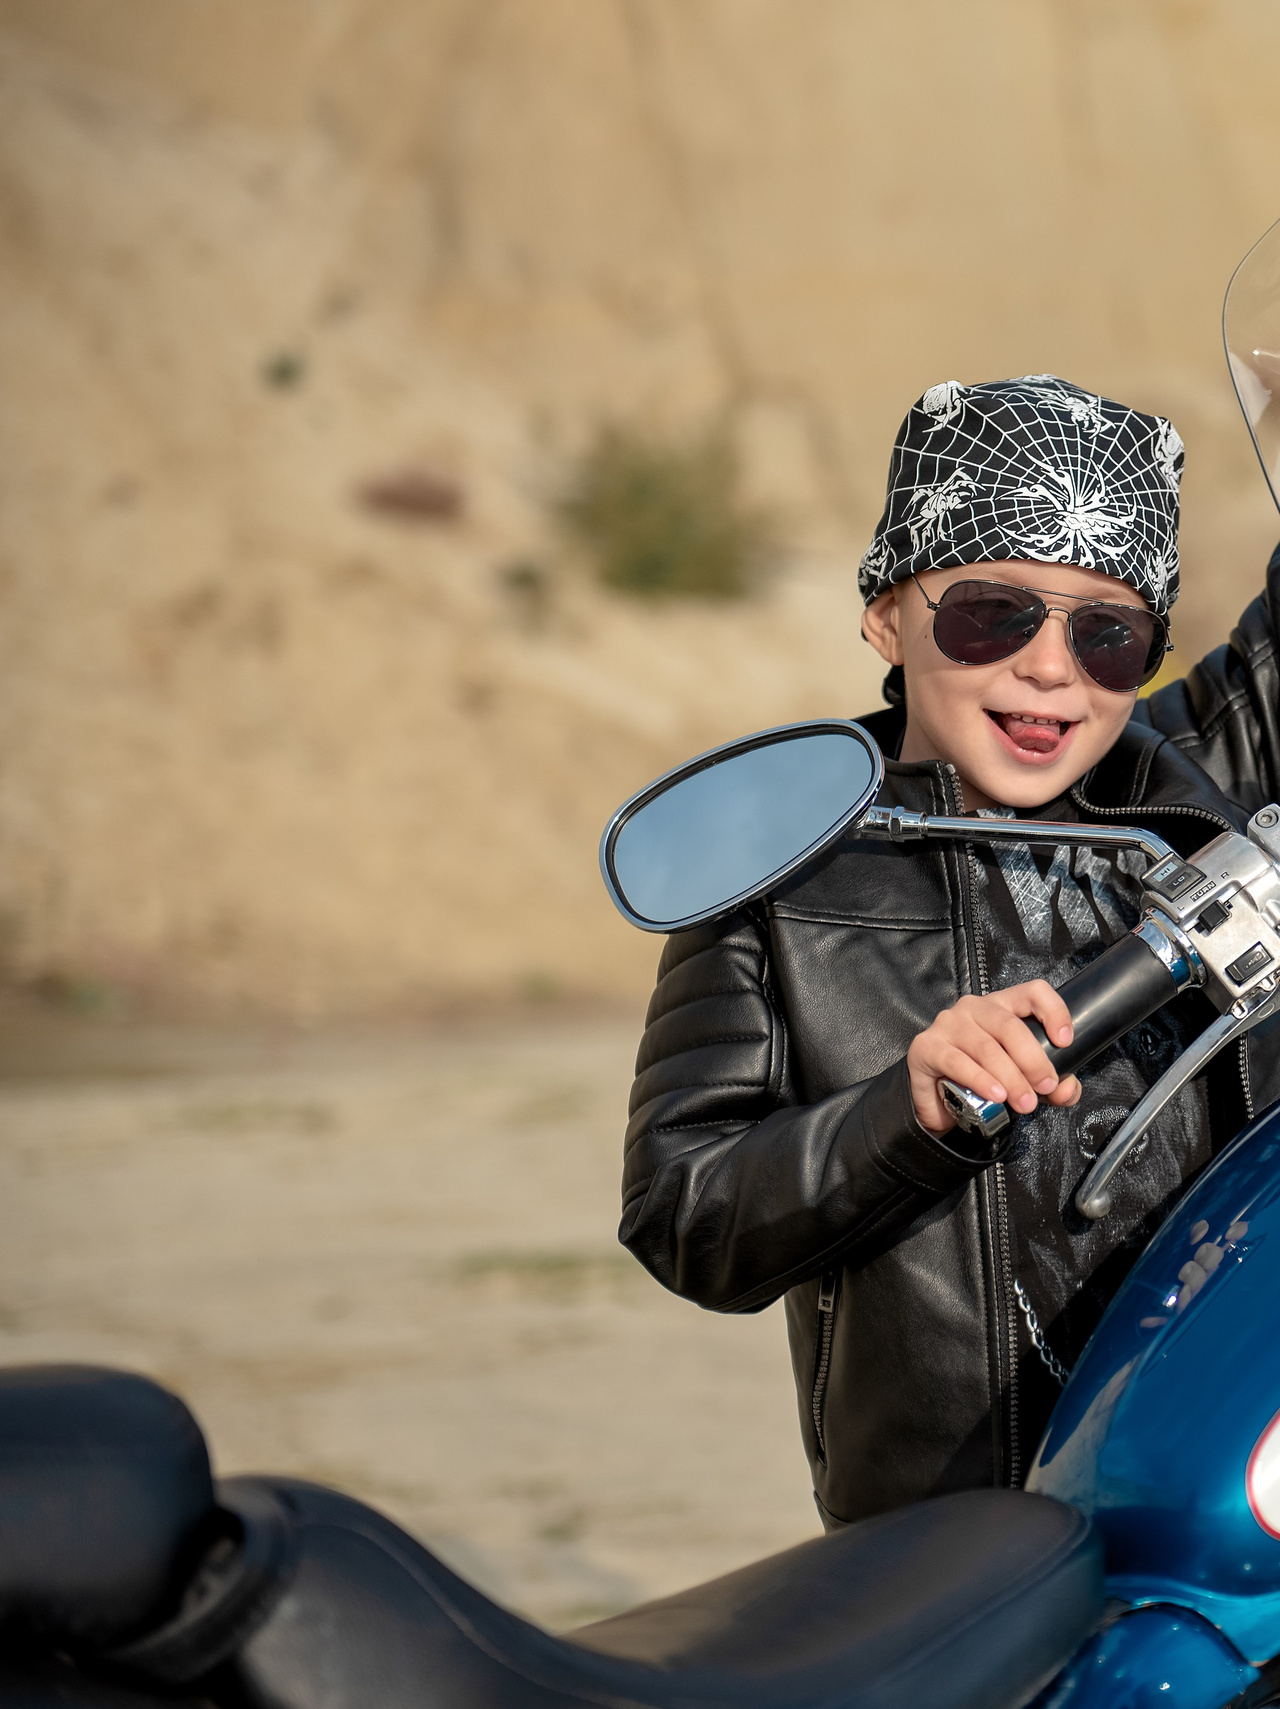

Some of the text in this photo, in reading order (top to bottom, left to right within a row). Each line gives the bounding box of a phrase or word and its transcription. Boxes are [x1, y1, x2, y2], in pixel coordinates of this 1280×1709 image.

[1160, 868, 1171, 877] HI
[1220, 871, 1230, 879] R
[1172, 875, 1185, 886] LO
[1191, 881, 1216, 901] TURN
